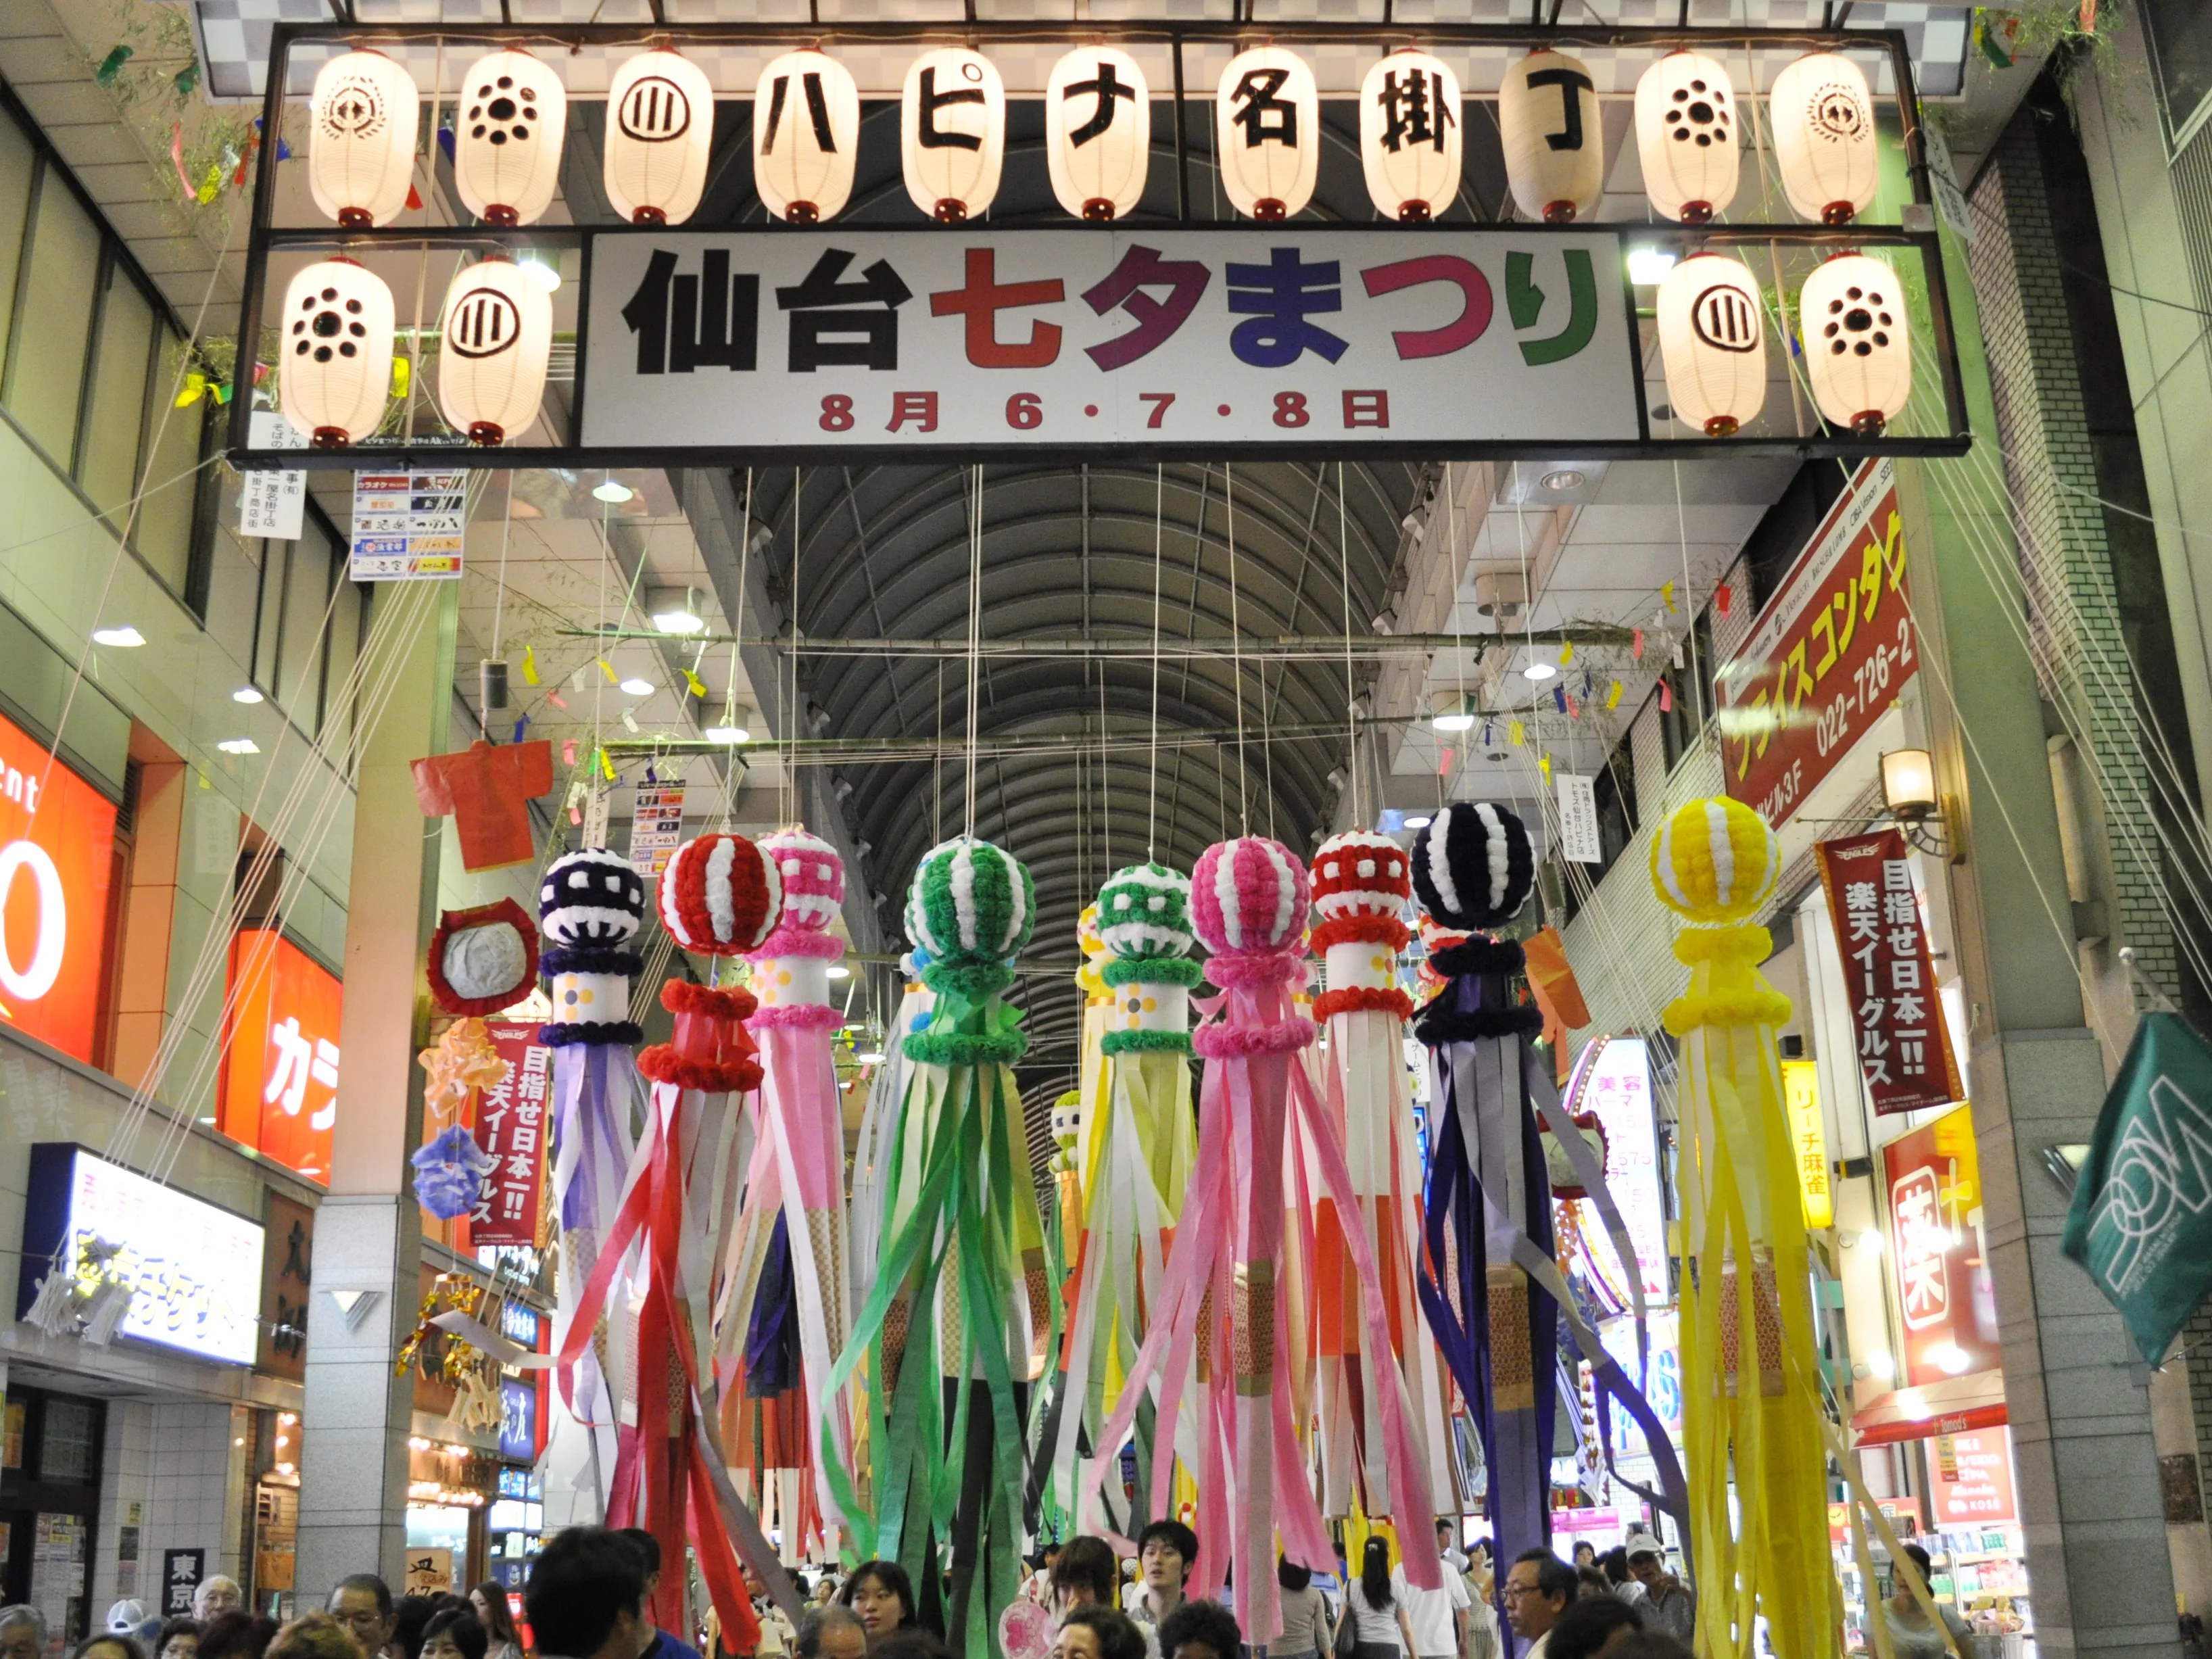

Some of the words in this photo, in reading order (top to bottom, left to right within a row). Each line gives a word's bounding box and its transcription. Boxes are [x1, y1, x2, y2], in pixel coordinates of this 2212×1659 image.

[621, 243, 1597, 375] 仙台七夕まつり
[1845, 882, 1892, 1086] 楽天イーグルス
[1598, 1076, 1641, 1092] 美容
[1798, 1090, 1825, 1195] リーチ麻雀
[170, 1554, 196, 1617] 東京
